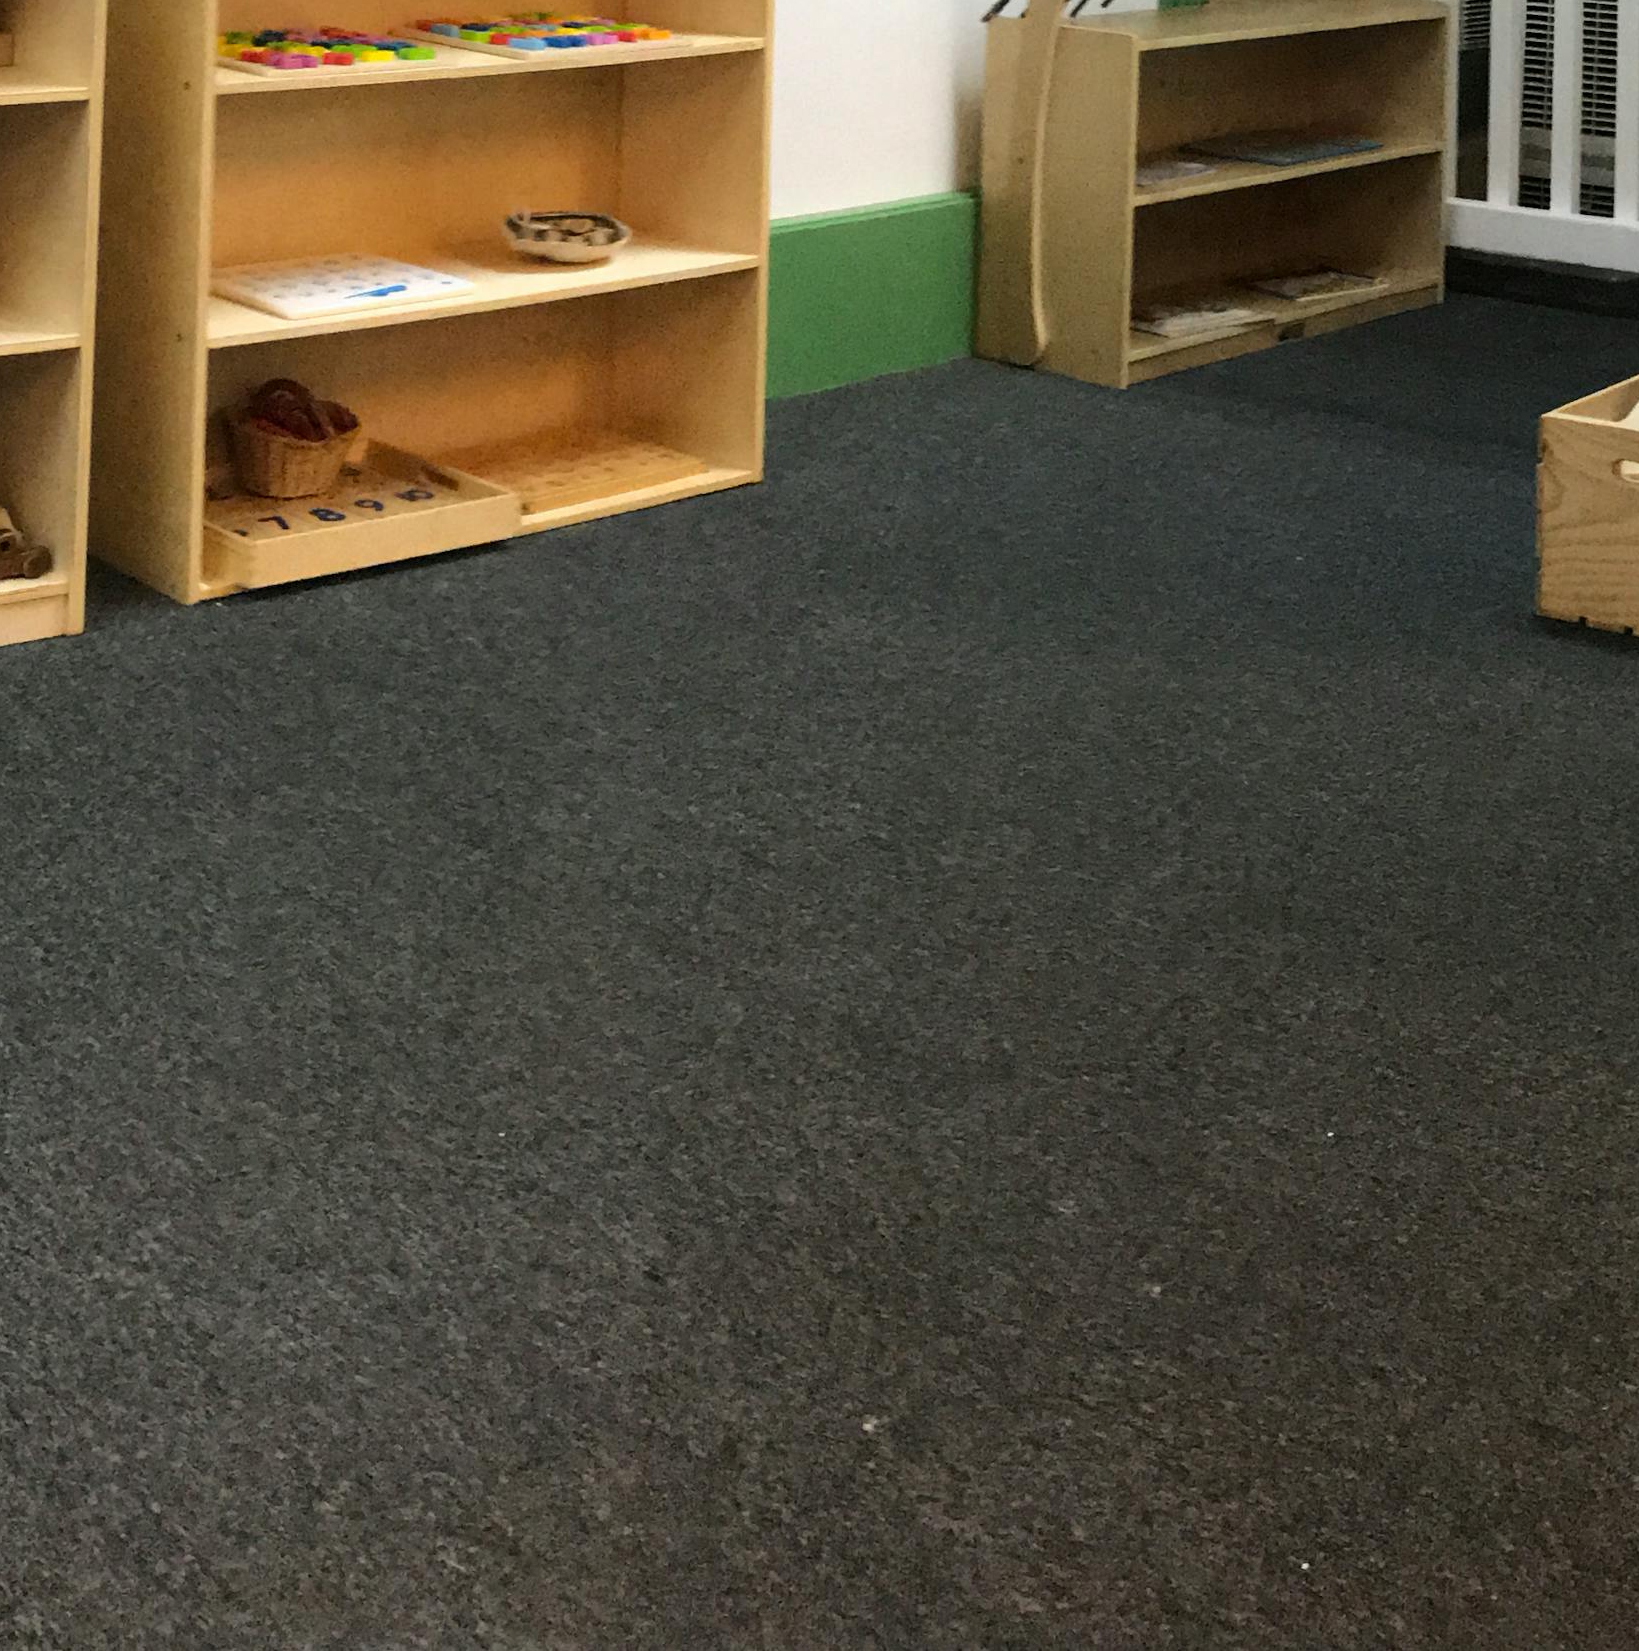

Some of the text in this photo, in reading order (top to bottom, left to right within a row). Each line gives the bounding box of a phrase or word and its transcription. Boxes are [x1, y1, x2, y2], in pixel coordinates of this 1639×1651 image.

[258, 515, 290, 530] 7
[308, 508, 346, 522] 8
[354, 499, 384, 512] 9
